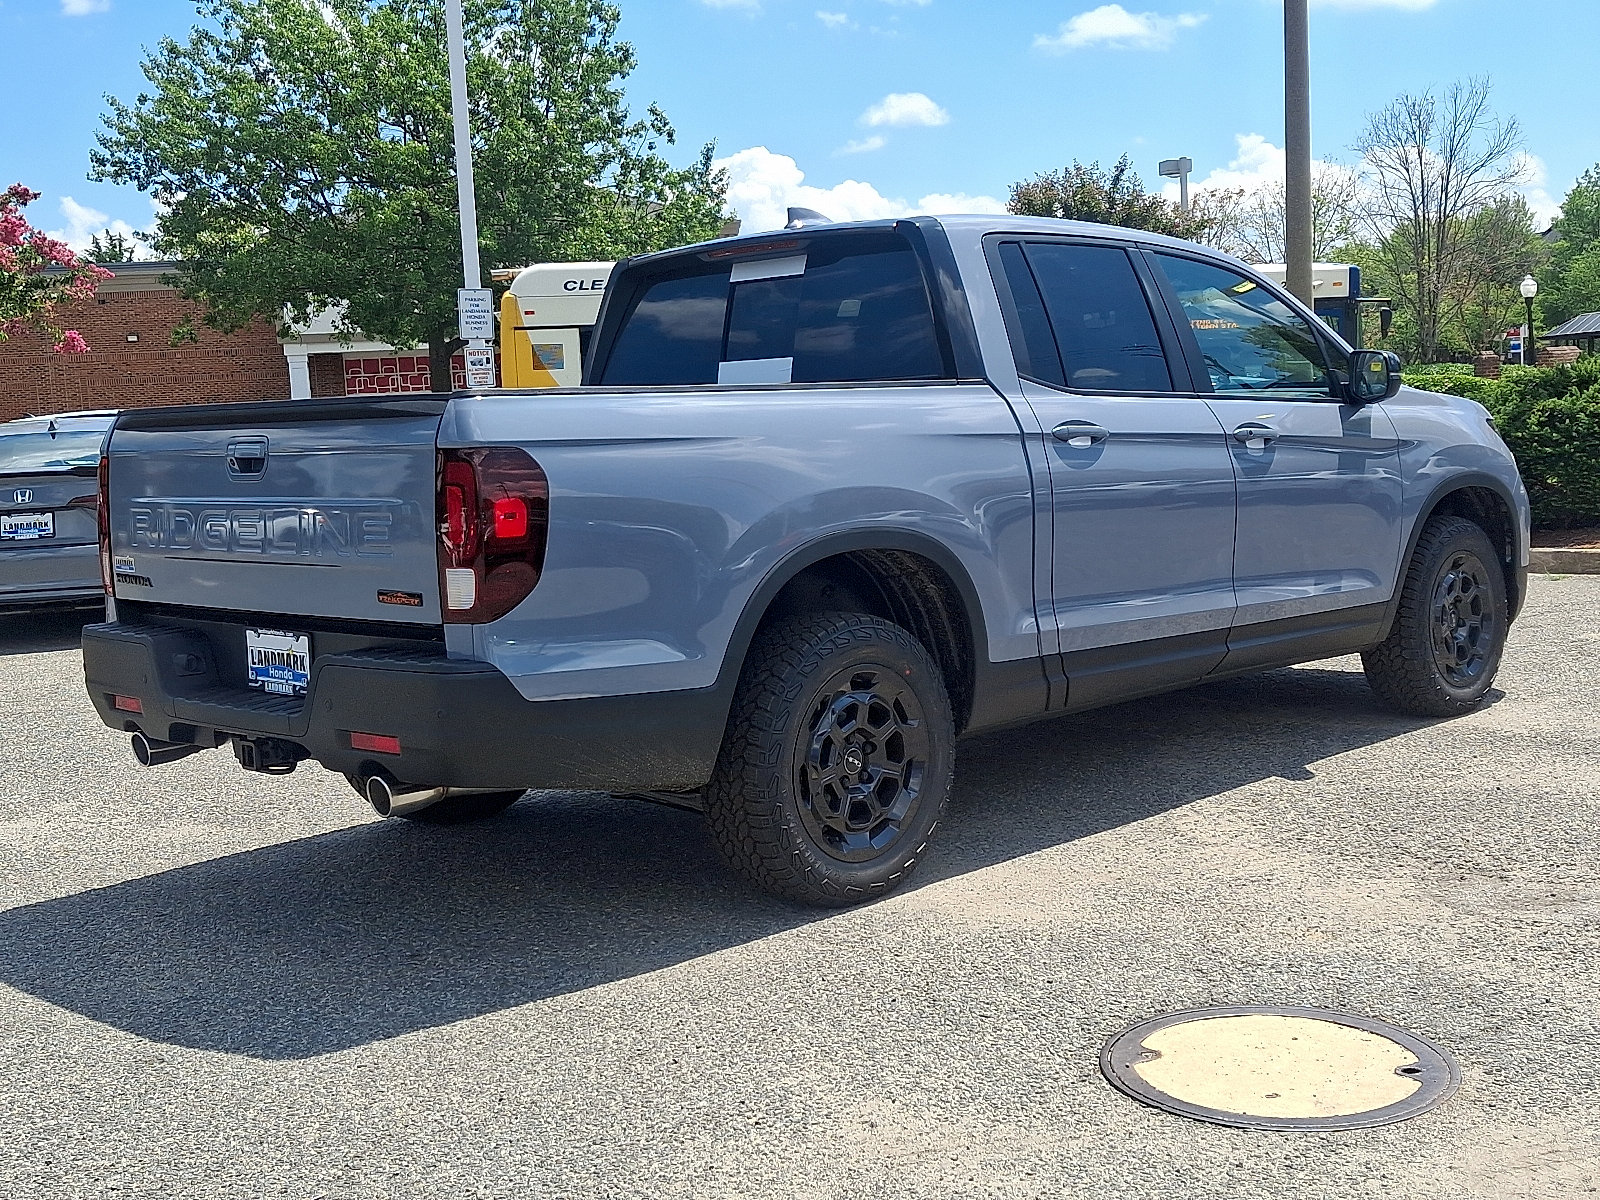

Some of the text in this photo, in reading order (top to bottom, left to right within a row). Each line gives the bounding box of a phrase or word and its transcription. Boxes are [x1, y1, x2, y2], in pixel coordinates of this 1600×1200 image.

[563, 279, 606, 291] CLE
[3, 520, 49, 531] LANDMARK
[129, 507, 394, 558] RIDGELINE
[116, 573, 154, 587] HONDA
[250, 648, 307, 672] LANDMARK
[269, 667, 293, 680] Honda
[265, 682, 294, 693] LANDMARK
